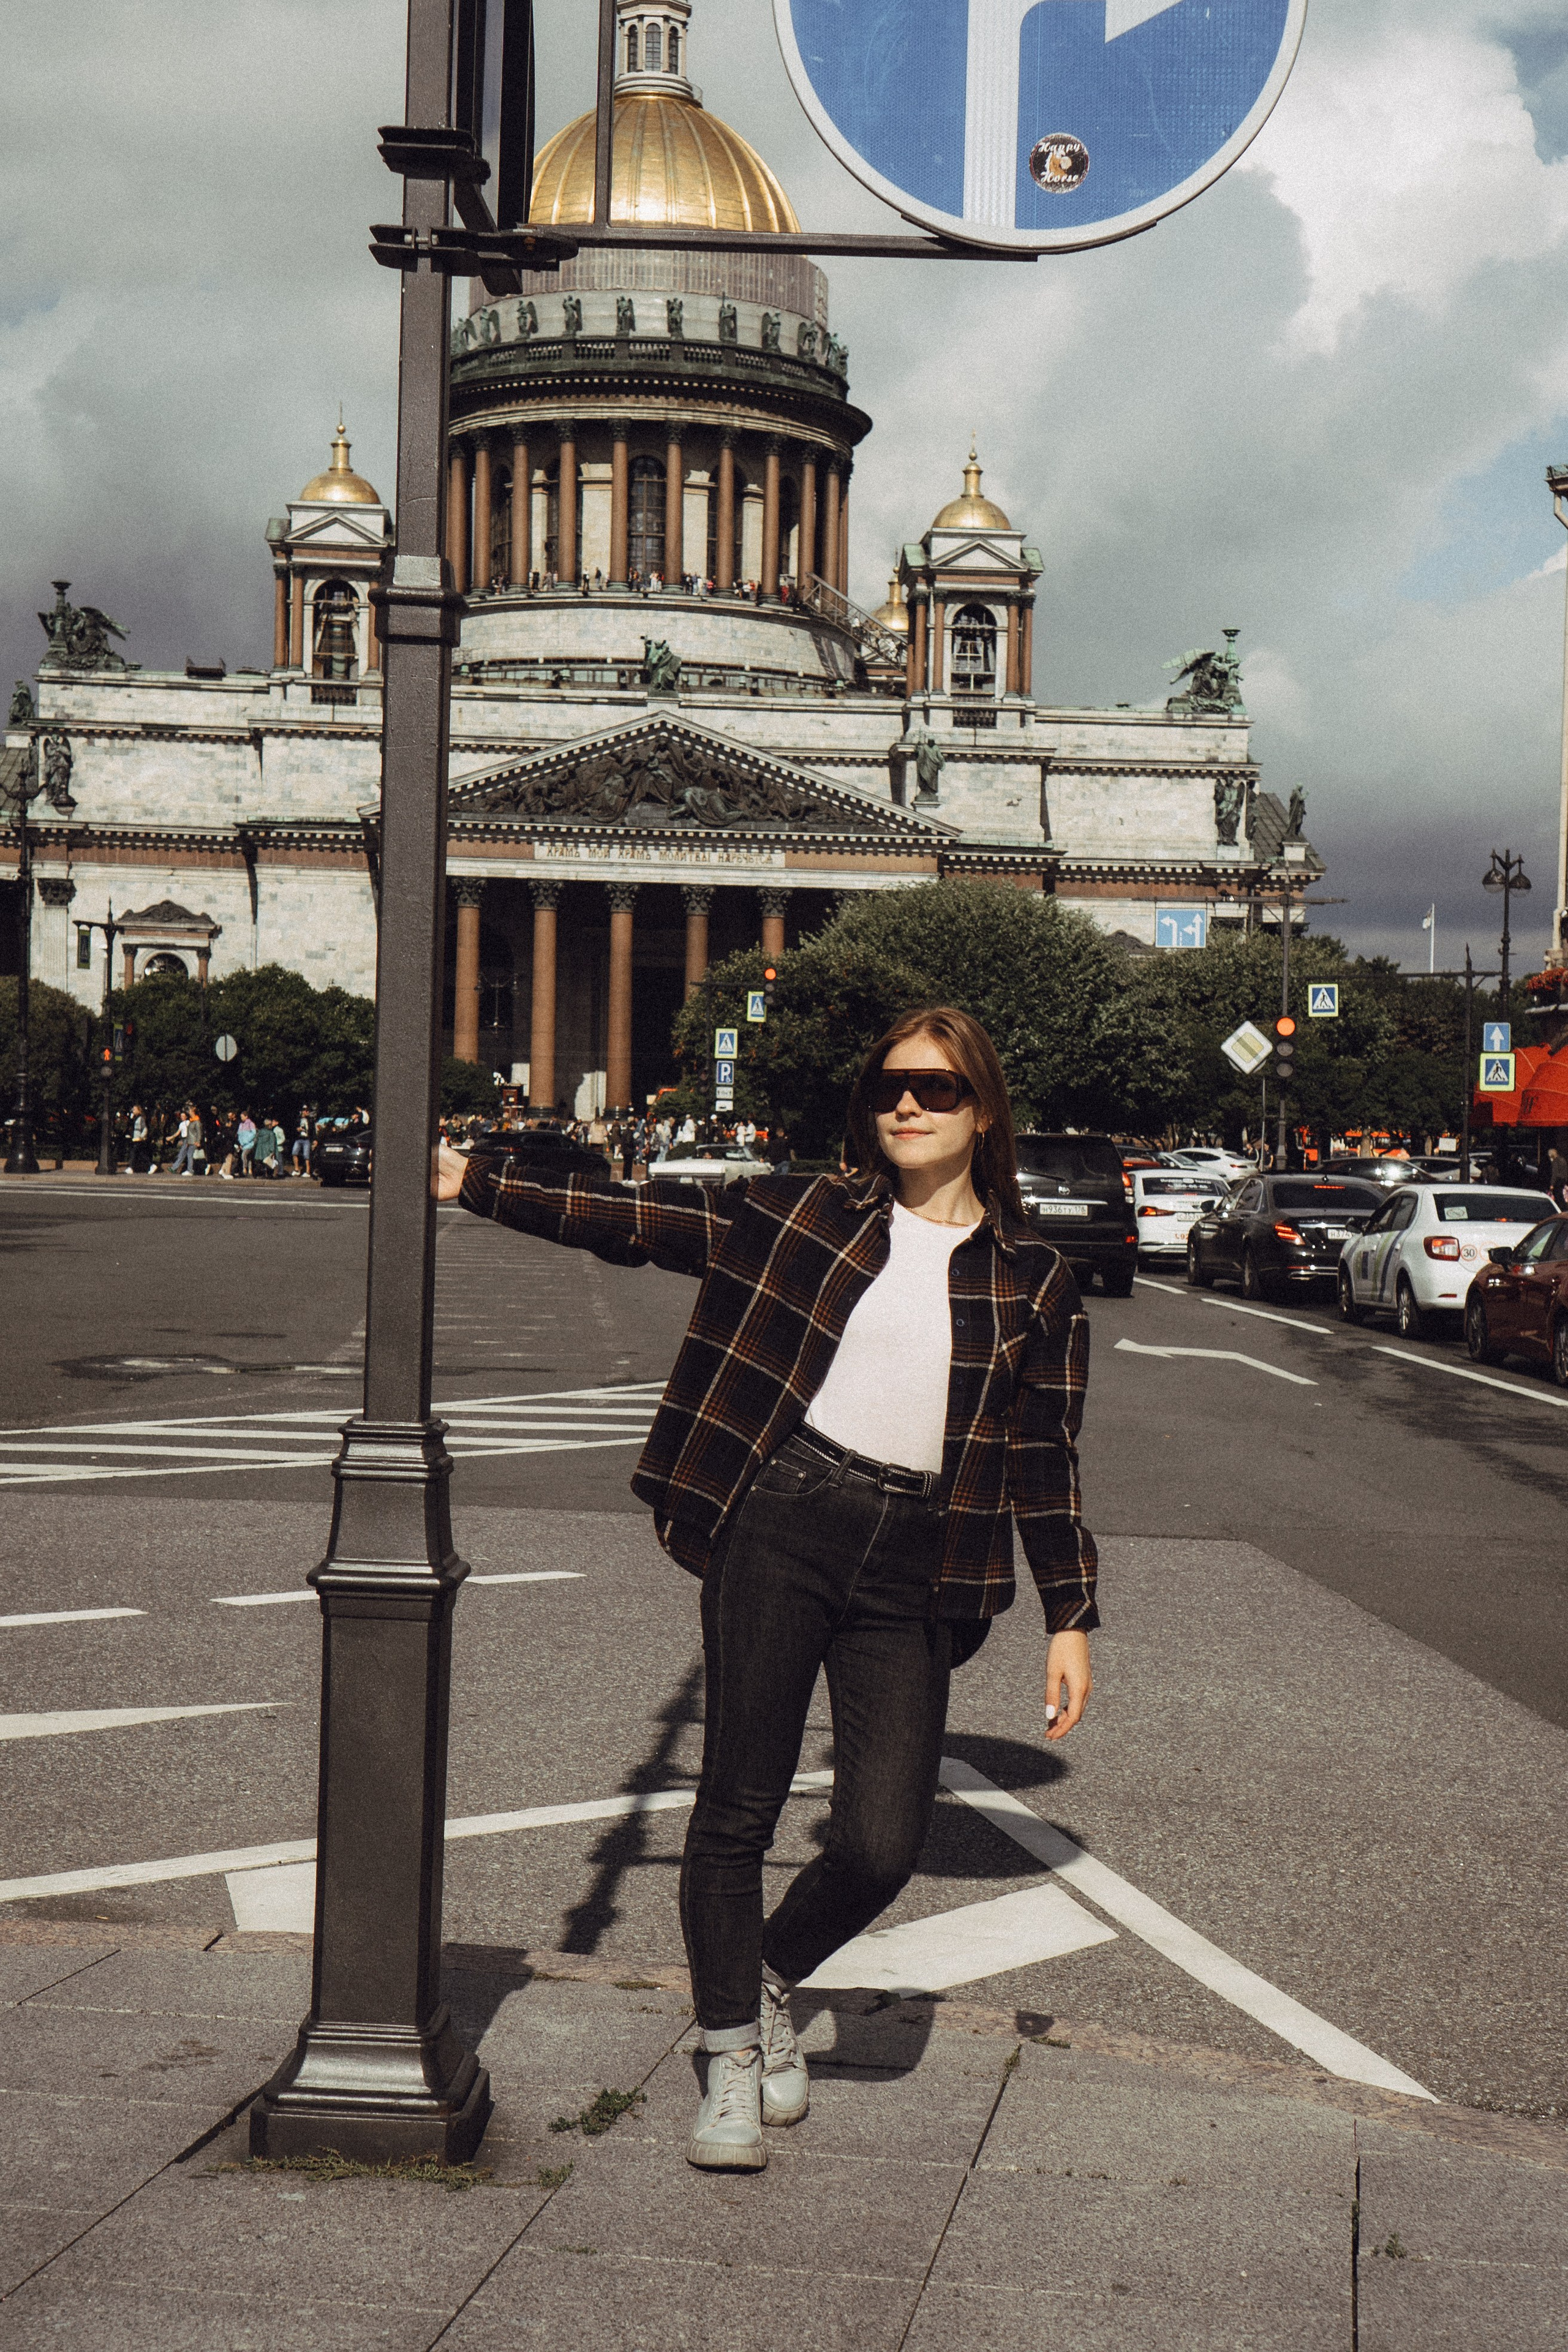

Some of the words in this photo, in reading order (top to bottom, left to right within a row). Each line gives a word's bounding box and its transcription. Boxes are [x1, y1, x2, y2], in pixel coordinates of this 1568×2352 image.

[1038, 141, 1080, 153] Happy
[1040, 172, 1079, 183] Horse
[721, 1063, 731, 1082] P
[1463, 1248, 1475, 1257] 30
